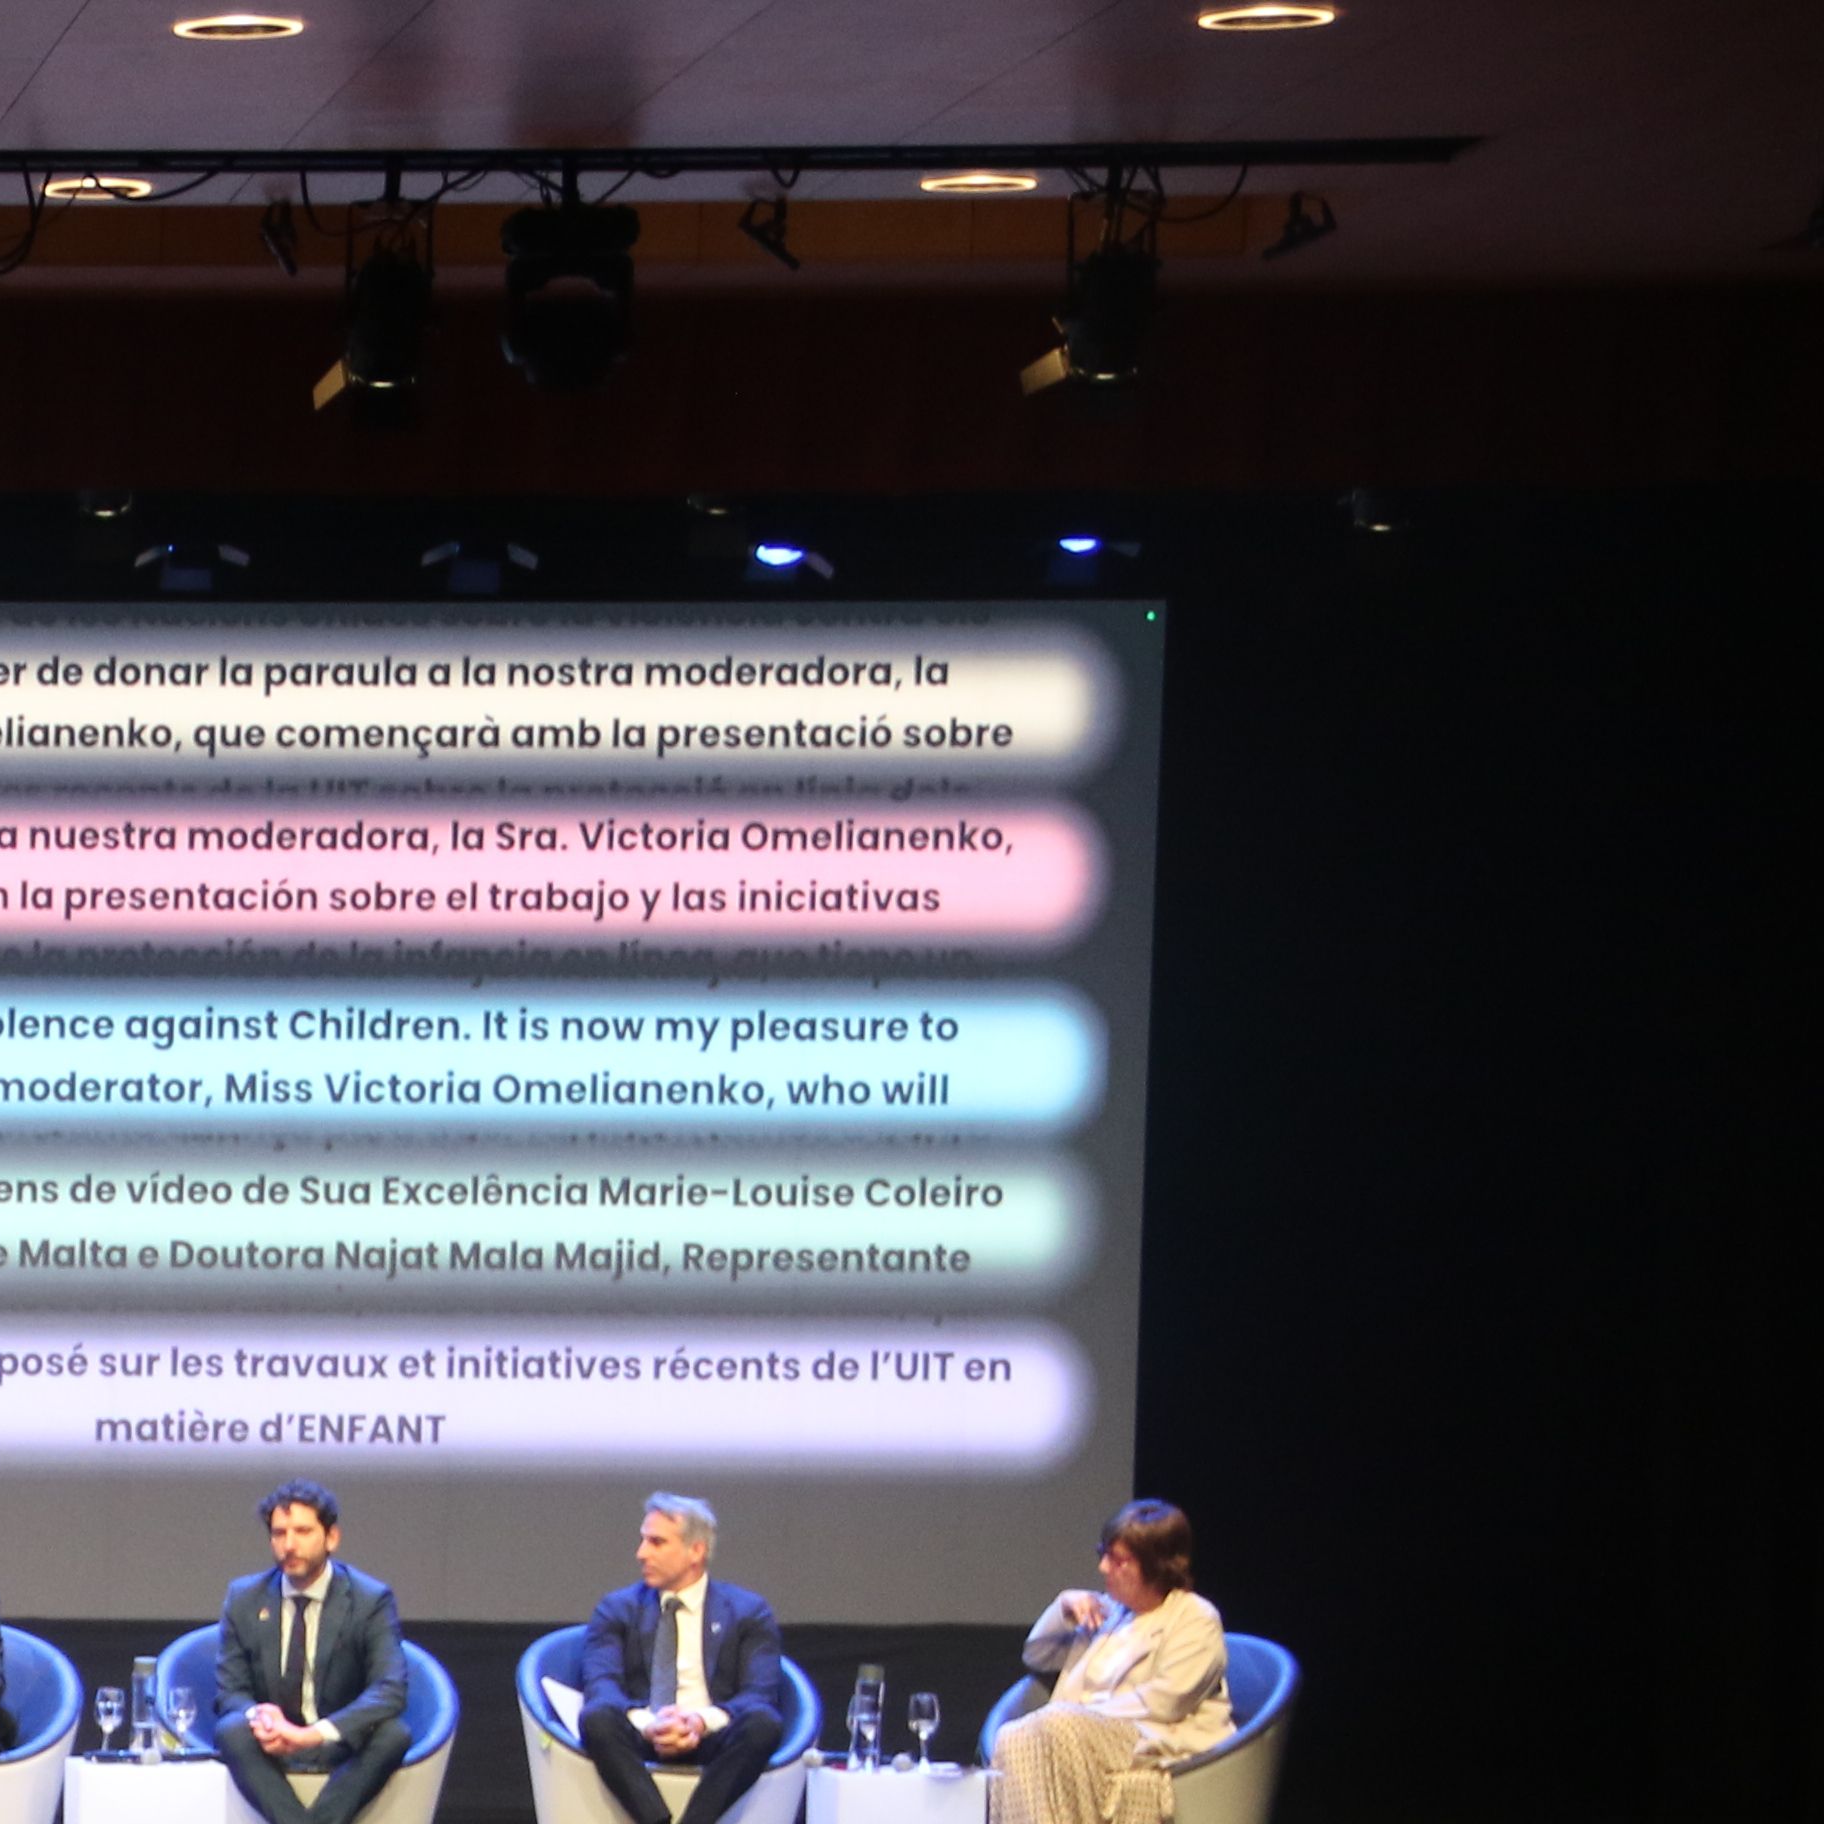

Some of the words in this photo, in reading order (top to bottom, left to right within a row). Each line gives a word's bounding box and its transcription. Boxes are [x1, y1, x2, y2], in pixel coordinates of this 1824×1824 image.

[37, 656, 83, 686] de
[94, 657, 209, 686] donar
[220, 657, 252, 686] la
[265, 657, 417, 696] paraula
[428, 664, 450, 686] a
[463, 657, 495, 686] la
[508, 659, 633, 686] nostra
[646, 656, 901, 690] moderadora,
[915, 656, 948, 685] la
[194, 725, 265, 757] que
[276, 717, 499, 757] començarà
[512, 719, 601, 748] amb
[613, 719, 645, 748] la
[658, 716, 892, 757] presentació
[904, 718, 1012, 747] sobre
[30, 823, 176, 850] nuestra
[188, 821, 438, 855] moderadora,
[452, 822, 484, 850] la
[497, 823, 567, 851] Sra.
[580, 820, 729, 851] Victoria
[742, 820, 1011, 854] Omelianenko,
[226, 1070, 312, 1103] Miss
[325, 1070, 480, 1103] Victoria
[493, 1071, 774, 1109] Omelianenko,
[787, 1074, 870, 1104] who
[883, 1072, 948, 1104] will
[19, 1238, 127, 1267] Malta
[138, 1246, 158, 1267] e
[170, 1240, 324, 1268] Doutora
[335, 1238, 438, 1278] Najat
[450, 1240, 543, 1269] Mala
[555, 1238, 670, 1279] Majid,
[683, 1243, 970, 1280] Representante
[96, 1410, 249, 1442] matière
